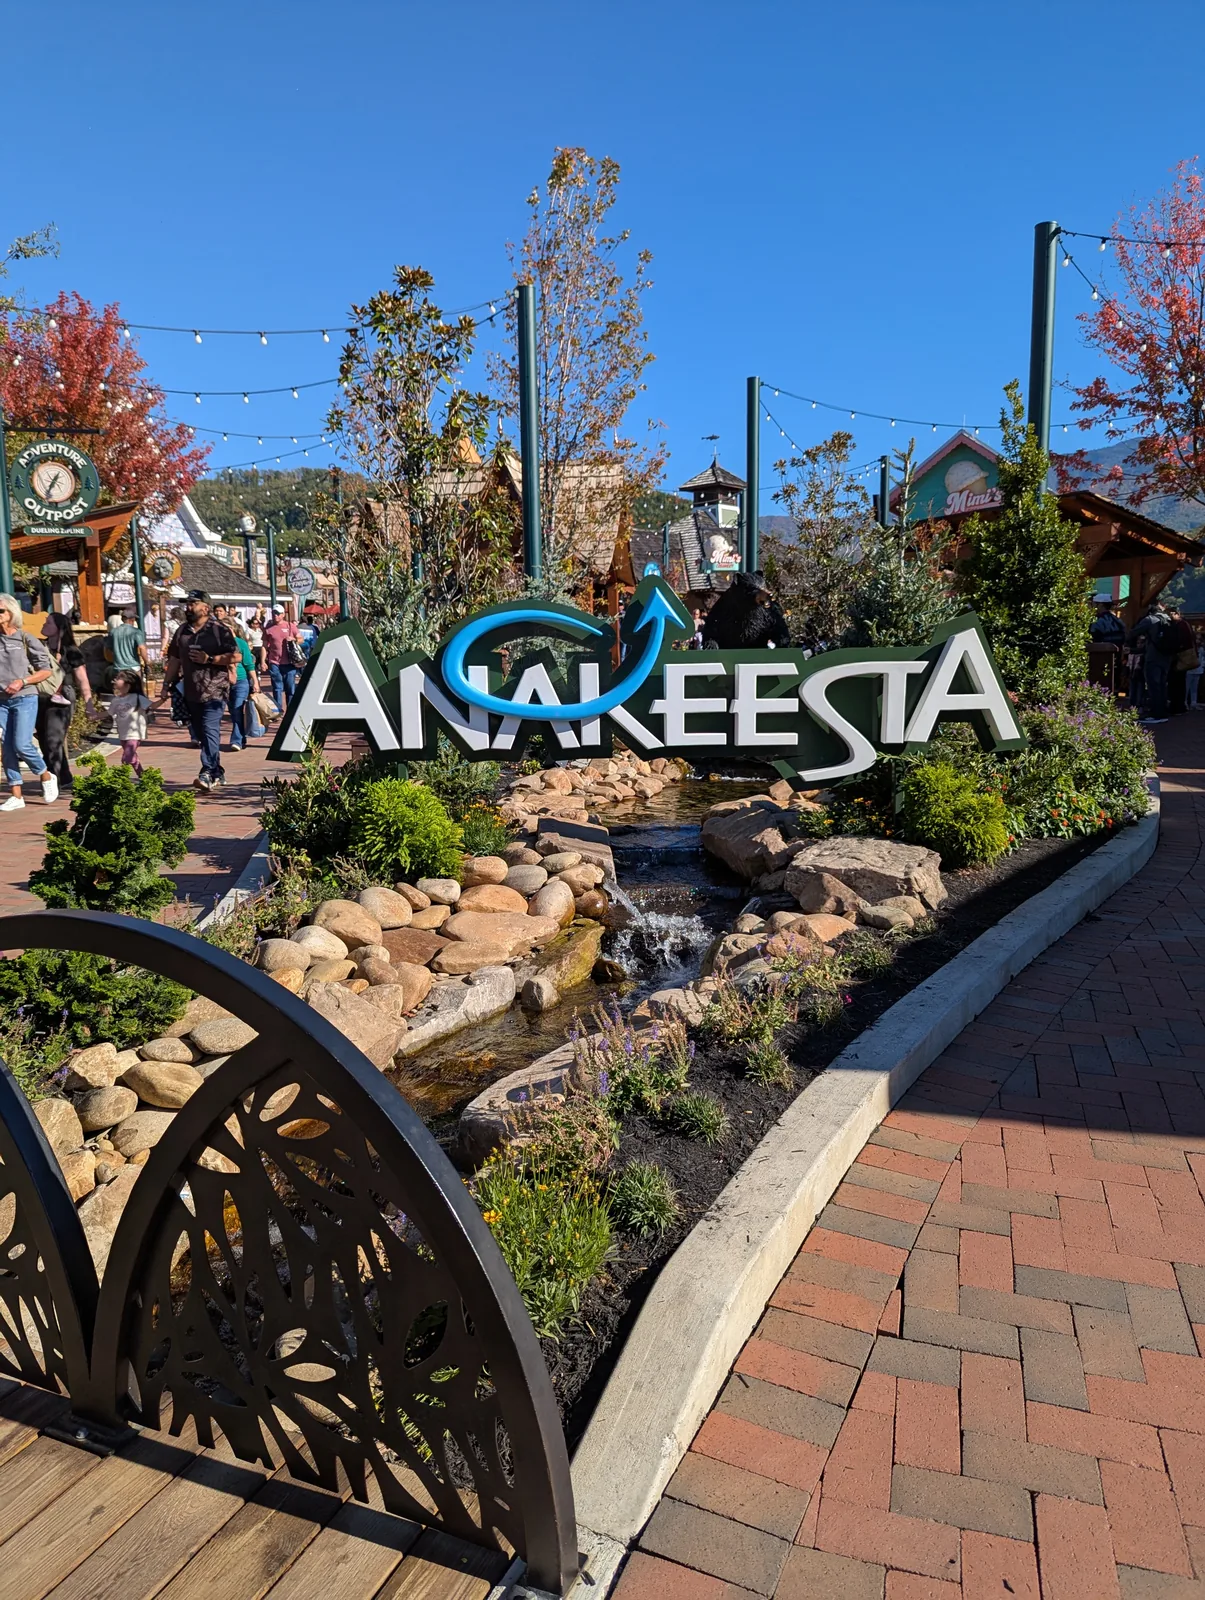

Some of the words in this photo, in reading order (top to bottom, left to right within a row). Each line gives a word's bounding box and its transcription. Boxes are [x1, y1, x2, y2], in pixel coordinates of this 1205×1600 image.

[19, 443, 87, 469] ADVENTURE
[24, 497, 89, 521] OUTPOST
[944, 487, 1003, 516] Mimi's
[710, 550, 742, 564] Mimi's
[278, 626, 1022, 782] ANAKEESTA
